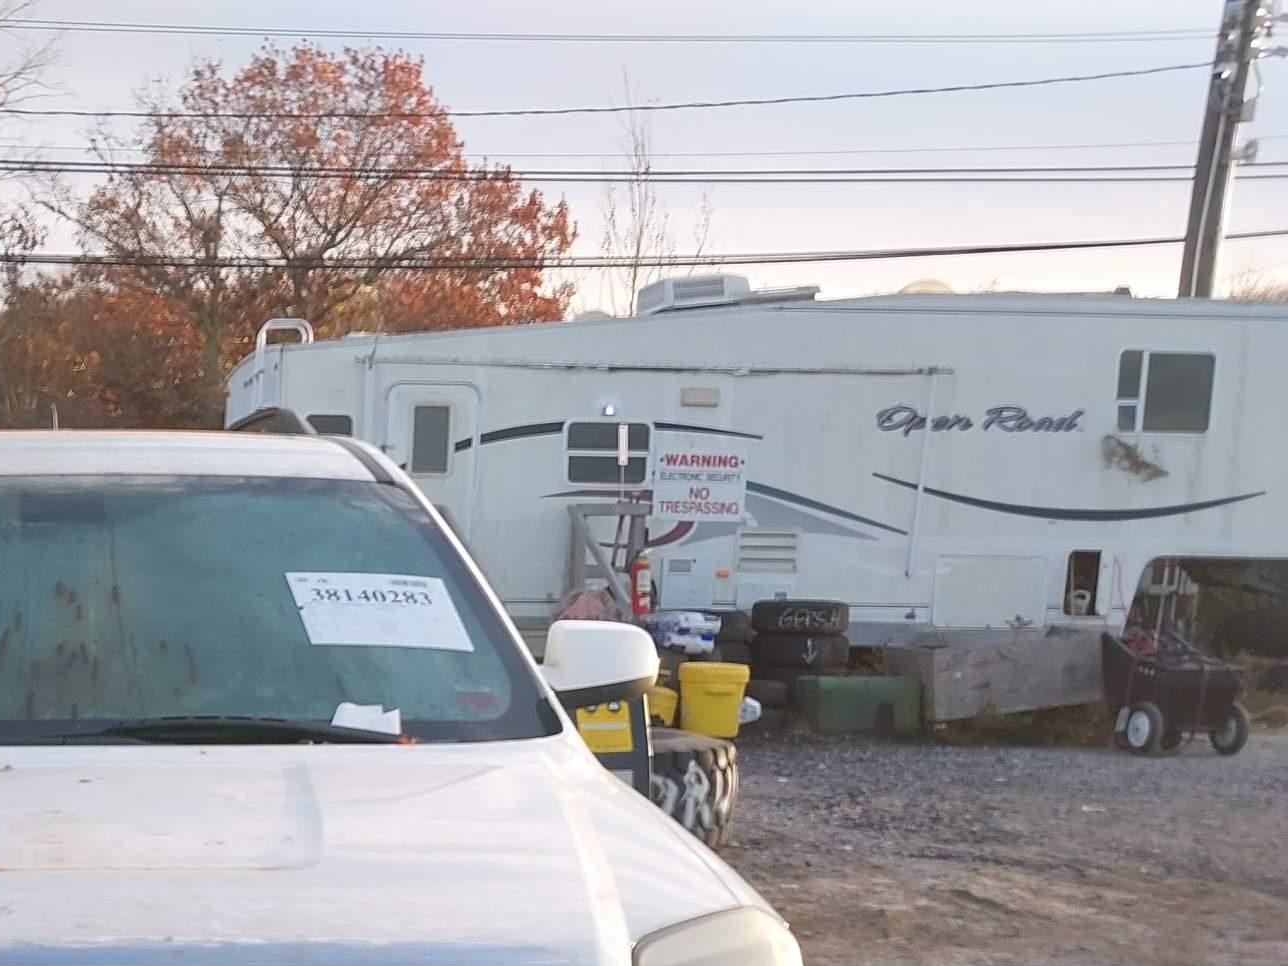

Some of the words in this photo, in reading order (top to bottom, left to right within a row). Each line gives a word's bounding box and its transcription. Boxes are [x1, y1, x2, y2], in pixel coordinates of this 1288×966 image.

[876, 404, 973, 437] Open
[982, 406, 1085, 433] Road
[665, 453, 739, 468] WARNING
[689, 487, 710, 500] NO
[659, 500, 739, 515] TRESPASSING
[310, 587, 434, 606] 38140283
